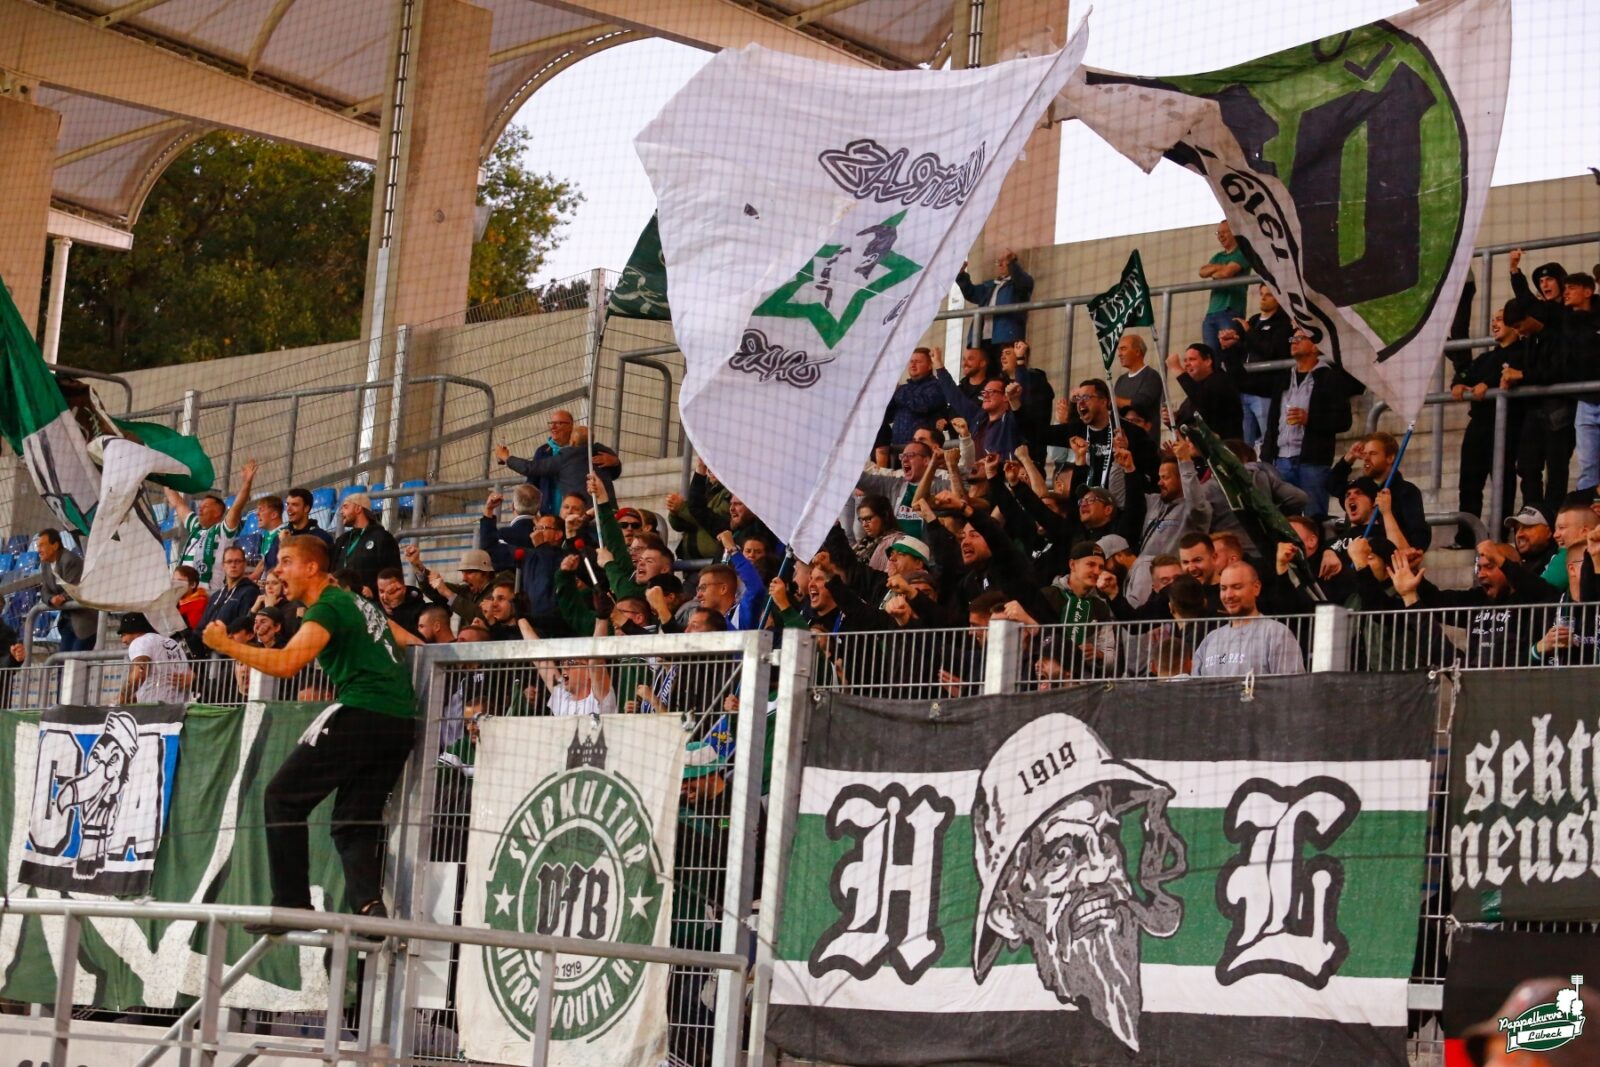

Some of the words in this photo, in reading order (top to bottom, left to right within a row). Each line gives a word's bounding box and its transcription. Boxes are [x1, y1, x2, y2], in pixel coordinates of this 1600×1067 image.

[1016, 740, 1079, 796] 1919
[508, 776, 648, 869] SUBKULTUR
[561, 960, 583, 978] 1919
